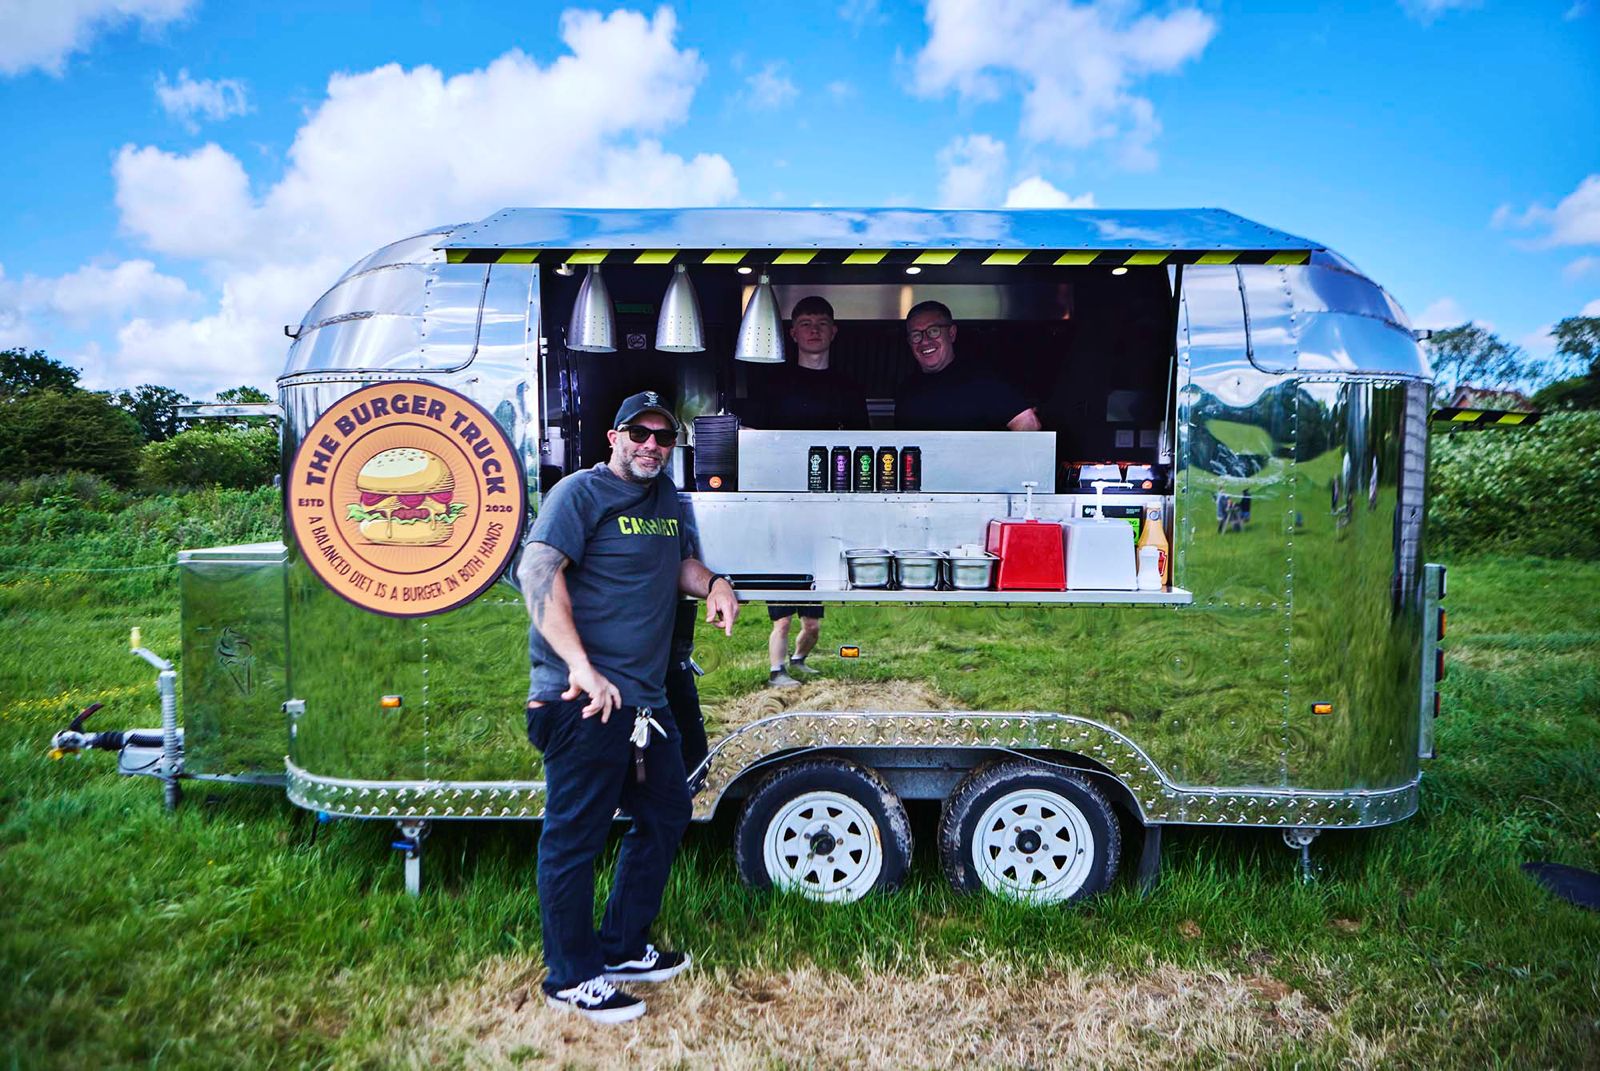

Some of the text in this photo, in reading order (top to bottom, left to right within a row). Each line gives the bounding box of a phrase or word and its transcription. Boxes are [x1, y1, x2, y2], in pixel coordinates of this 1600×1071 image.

[306, 394, 506, 496] THE BURGER TRUCK
[298, 498, 325, 507] ESTD
[485, 504, 513, 513] 2020
[308, 516, 504, 602] A BALANCED DIET IS A BURGER IN BOTH HANDS
